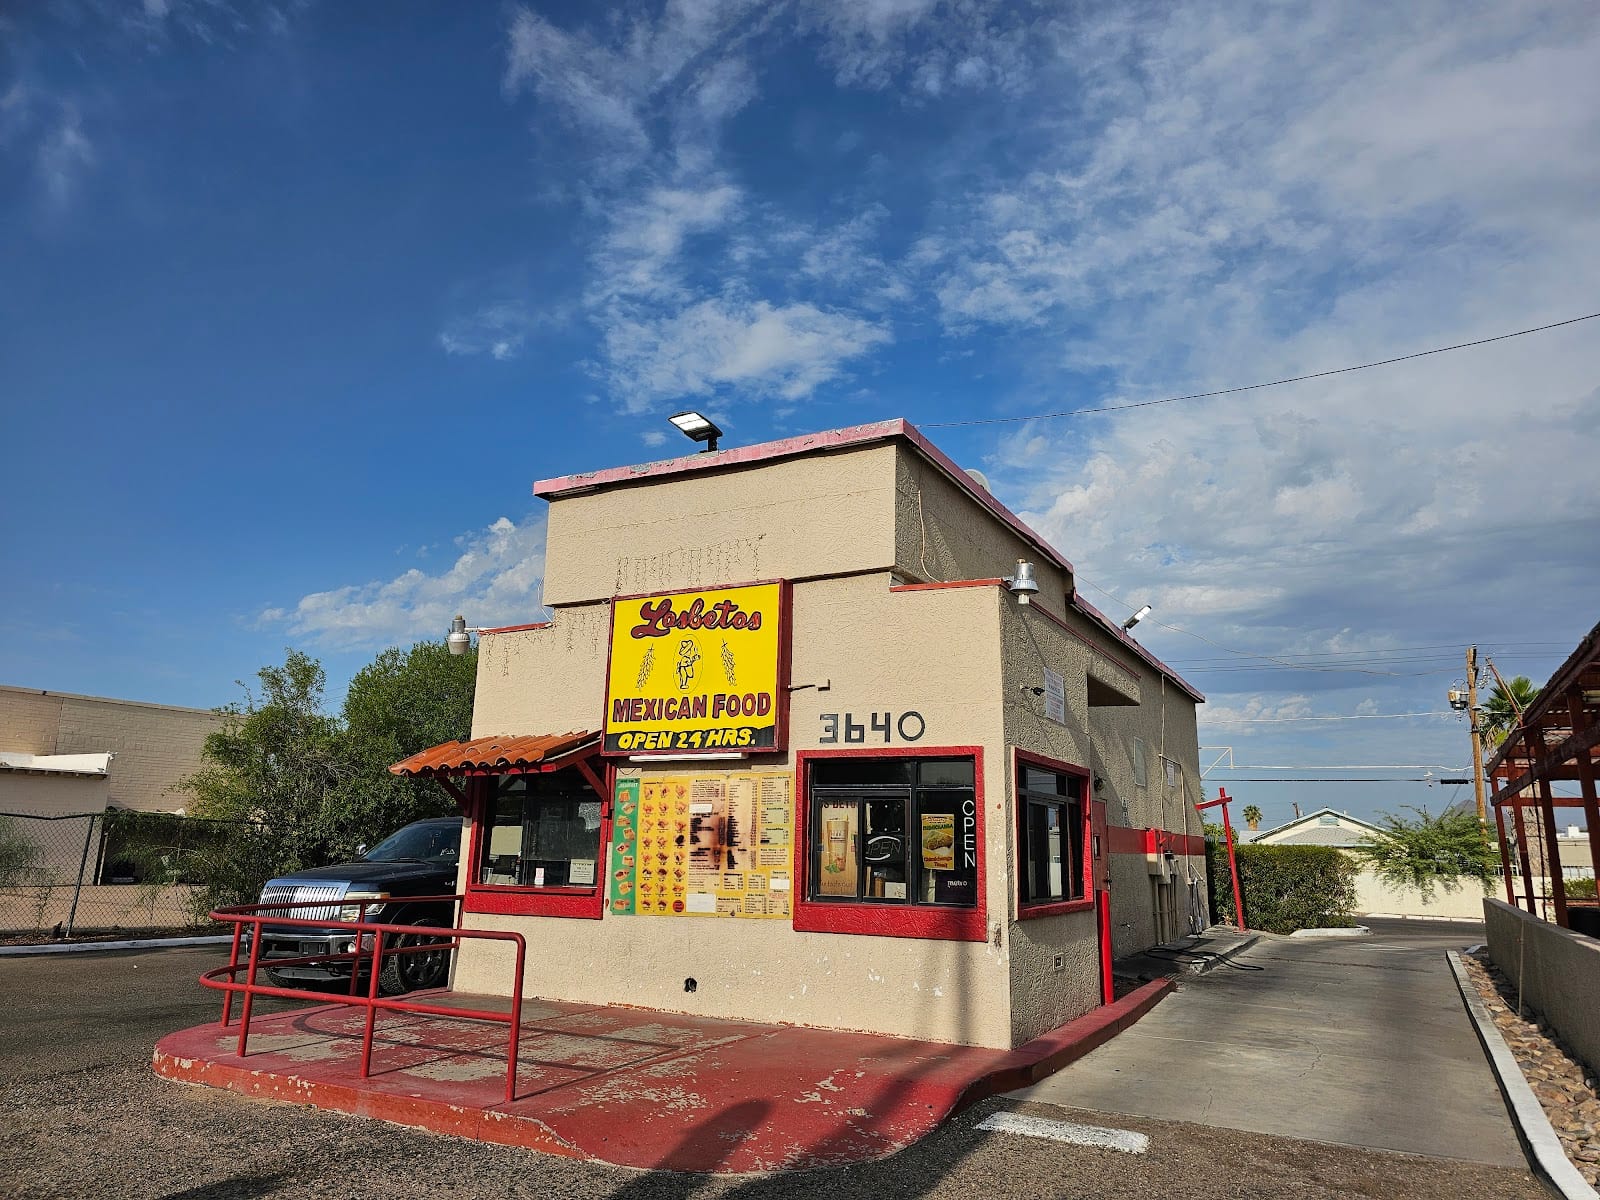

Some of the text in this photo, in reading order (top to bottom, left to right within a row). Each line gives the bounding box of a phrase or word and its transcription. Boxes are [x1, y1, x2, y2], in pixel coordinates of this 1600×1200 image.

[612, 693, 771, 723] MEXICAN FOOD
[618, 728, 756, 749] OPEN 24 HRS.
[819, 711, 926, 743] 3640
[962, 800, 976, 869] OPEN
